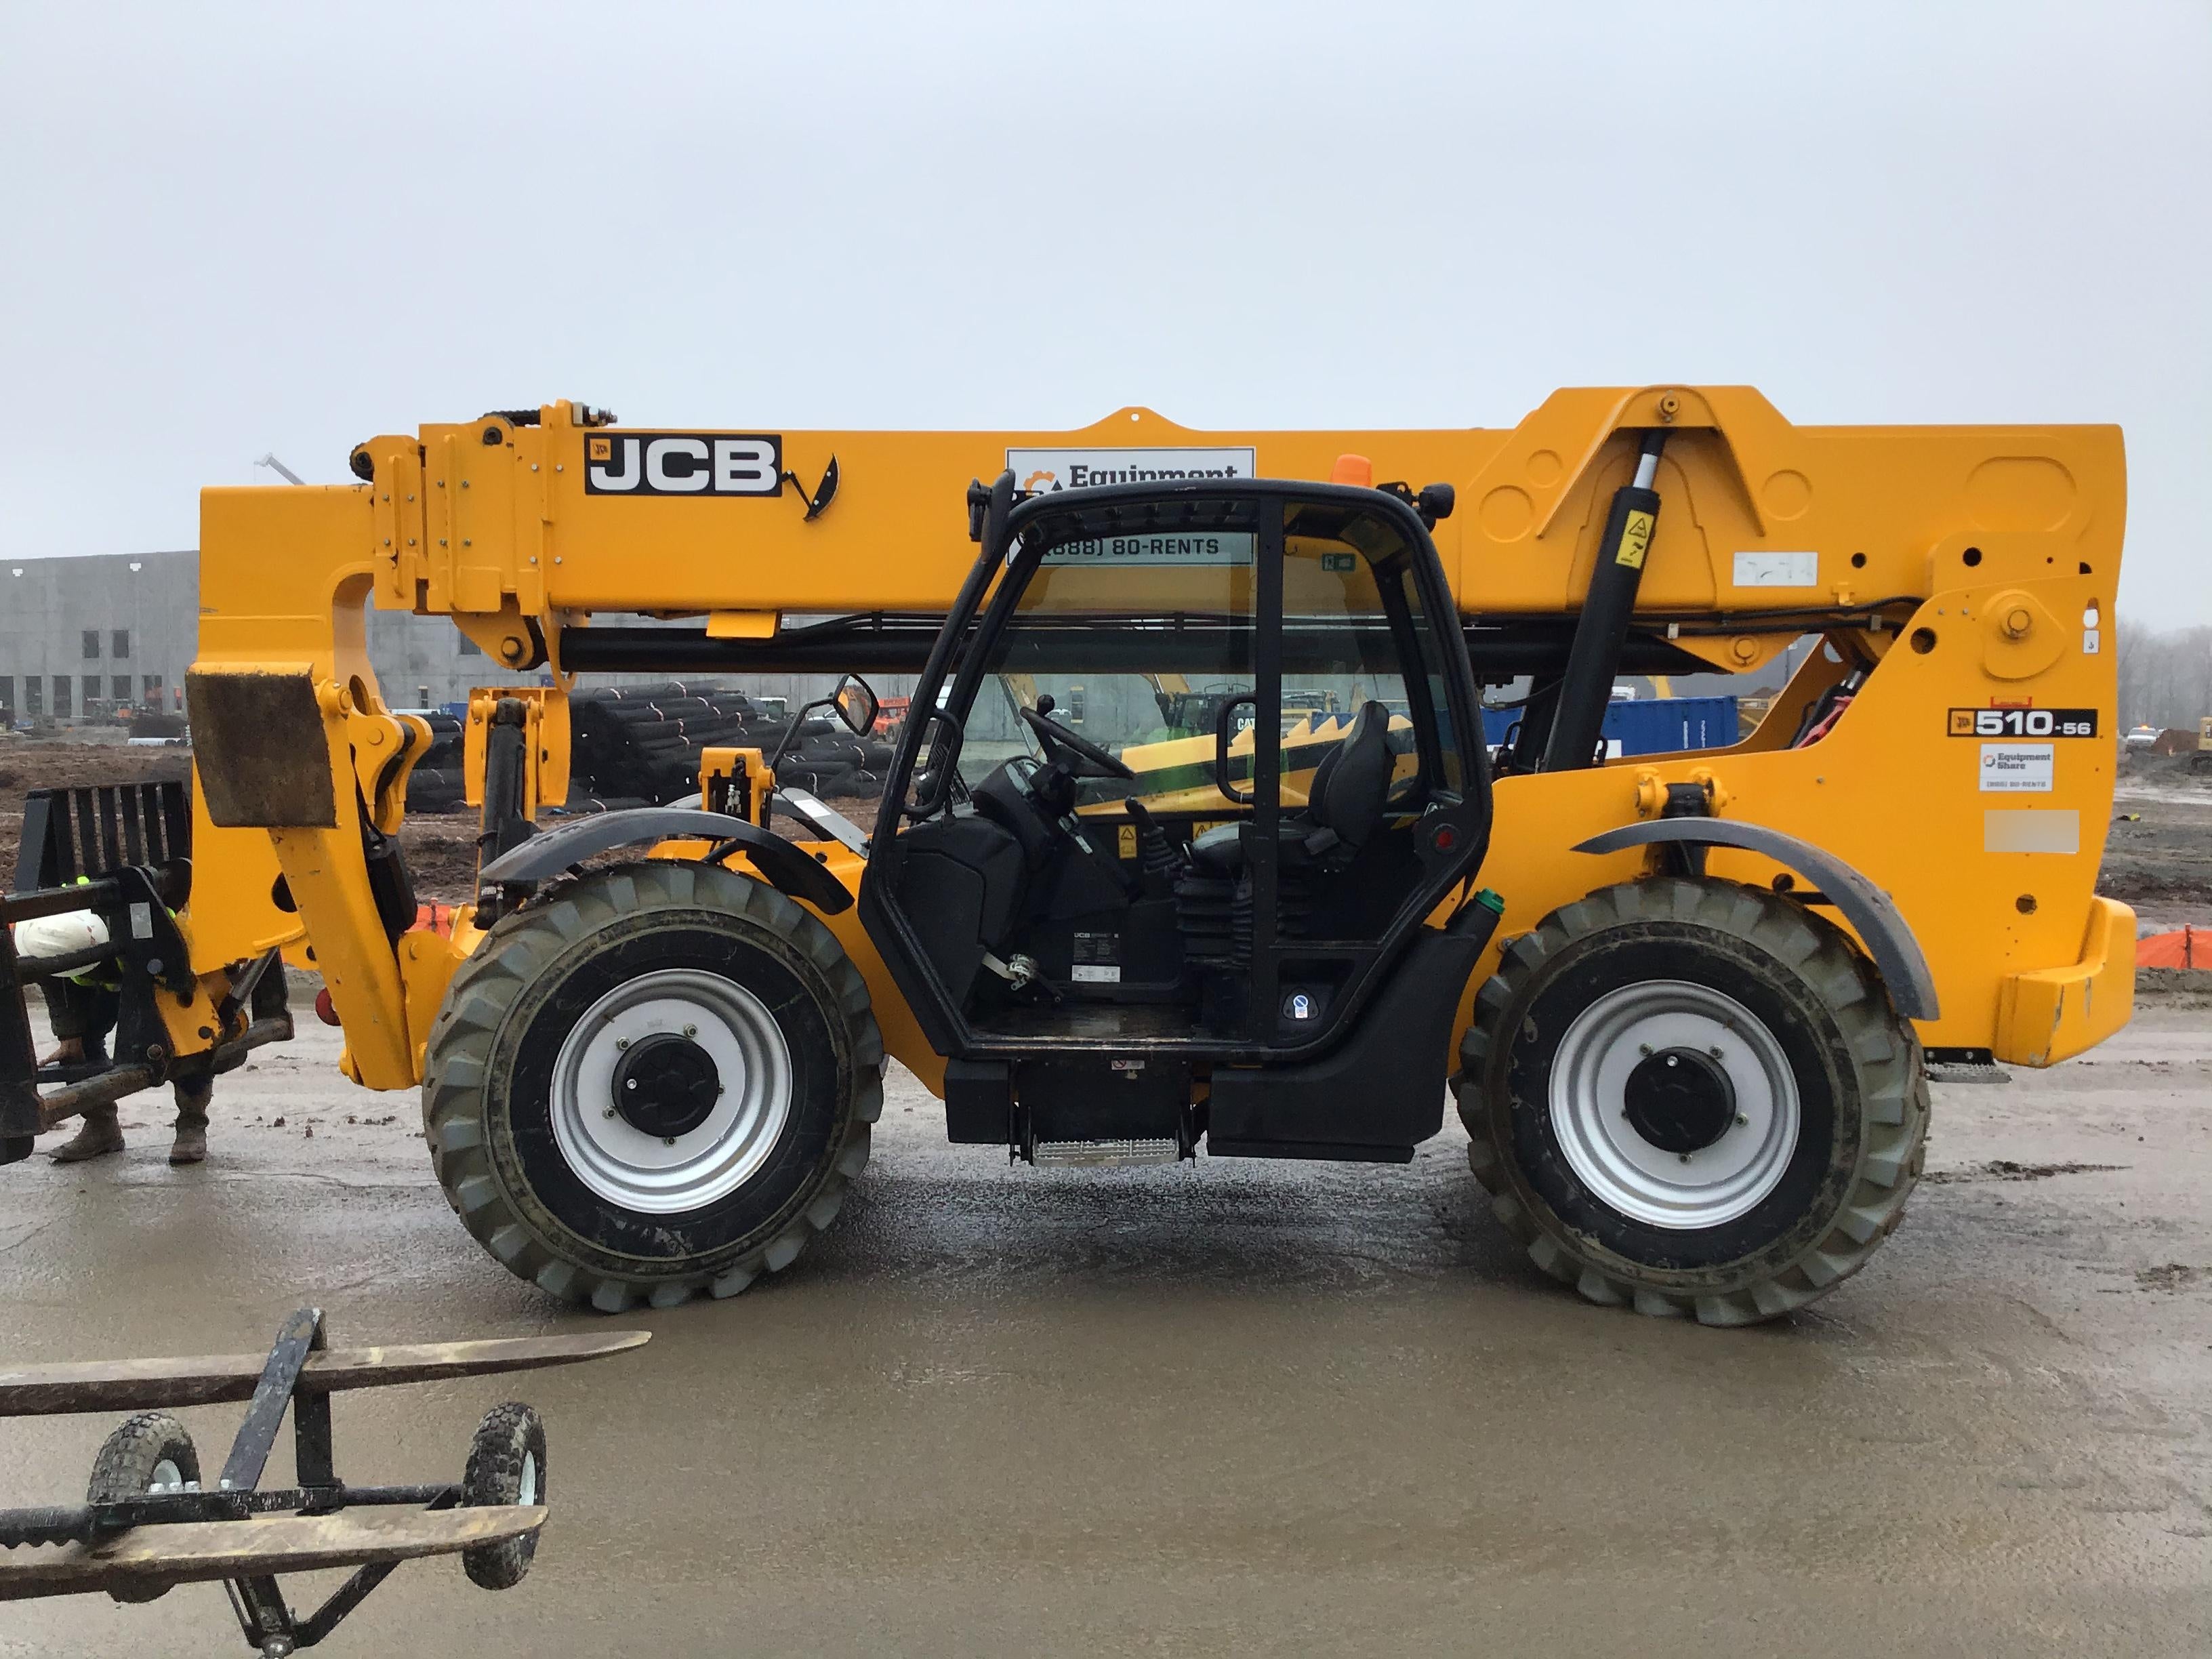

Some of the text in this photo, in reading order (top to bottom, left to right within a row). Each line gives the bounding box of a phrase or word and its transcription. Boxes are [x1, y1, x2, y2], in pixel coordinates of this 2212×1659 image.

[590, 438, 777, 491] JCB
[1046, 539, 1220, 556] 888) 80-RENTS
[1997, 753, 2051, 762] Equipment
